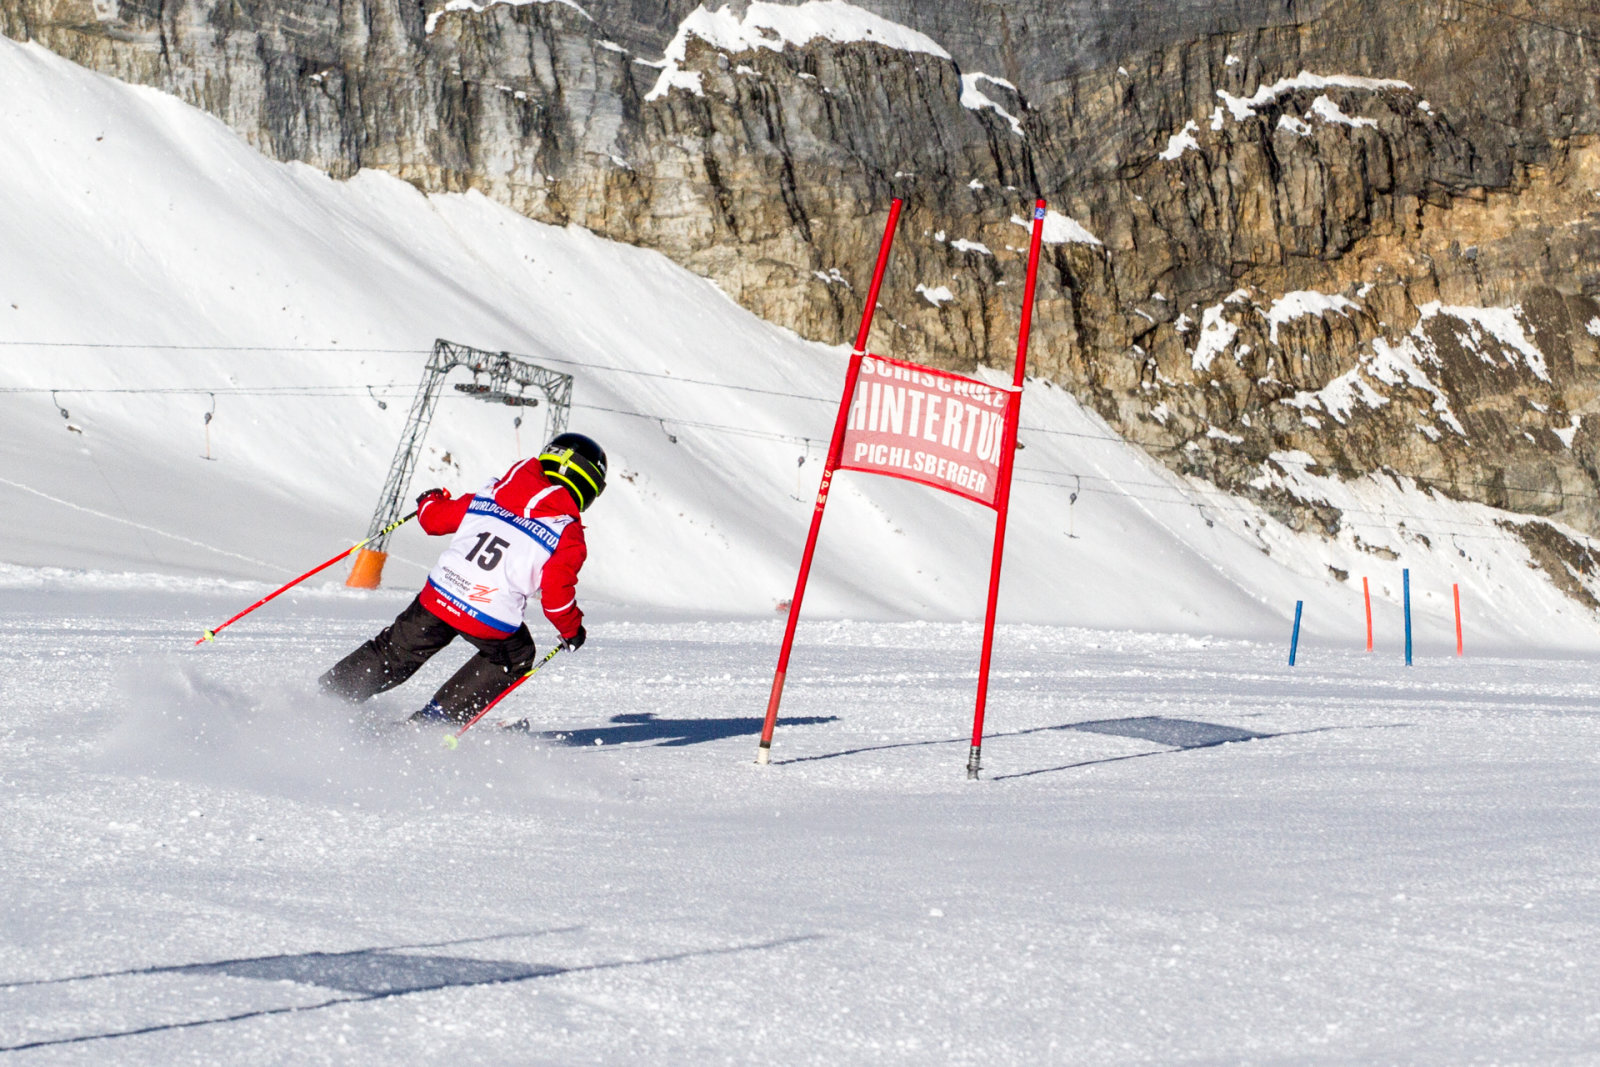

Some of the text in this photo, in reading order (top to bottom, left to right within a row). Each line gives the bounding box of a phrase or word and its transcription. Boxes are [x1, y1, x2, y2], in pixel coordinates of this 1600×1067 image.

[854, 442, 987, 493] PICHLSBERGER
[468, 499, 559, 550] WORLDCUP HINTERTUX
[465, 532, 510, 571] 15
